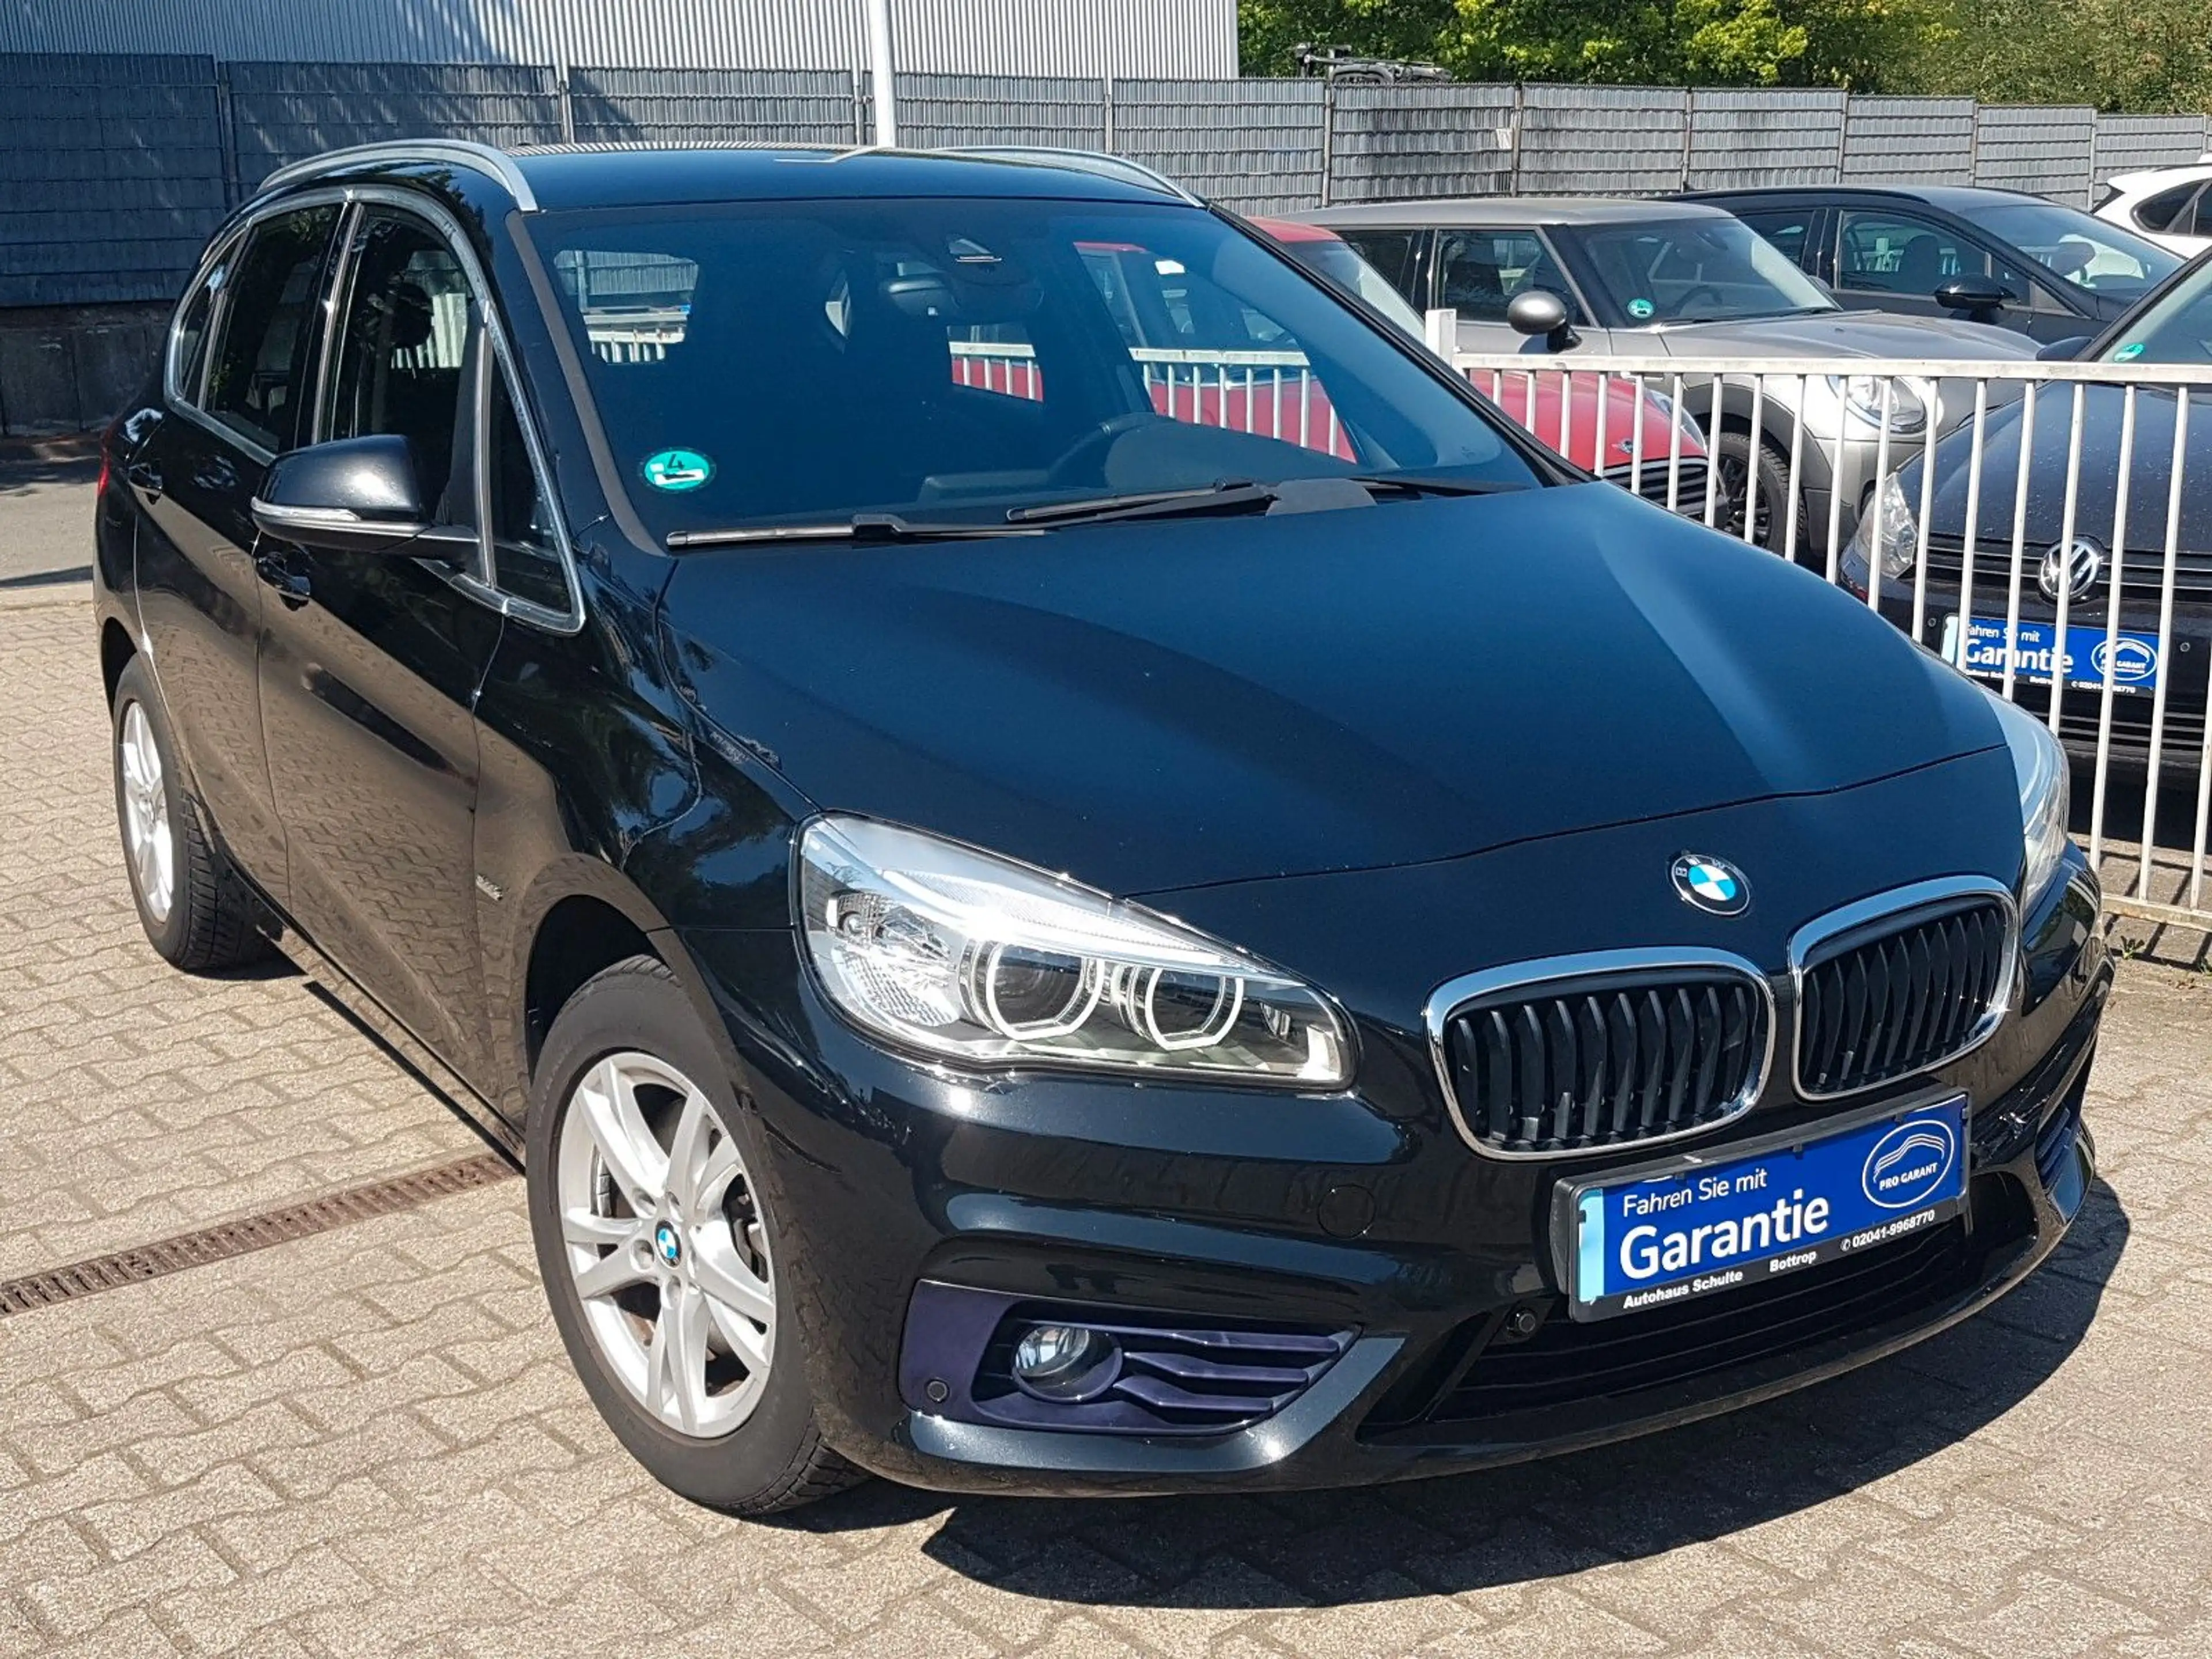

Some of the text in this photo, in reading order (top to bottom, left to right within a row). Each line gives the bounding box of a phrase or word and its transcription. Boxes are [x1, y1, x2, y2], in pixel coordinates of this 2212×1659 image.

[667, 453, 684, 469] 4
[2021, 630, 2040, 642] mit
[1623, 1168, 1768, 1218] Fahren Sie mit
[1878, 1162, 1938, 1191] PRO GARANT
[1620, 1188, 1829, 1280] Garantie
[1623, 1209, 1936, 1309] Autohaus Schulte Bottrop 02041-9968770
